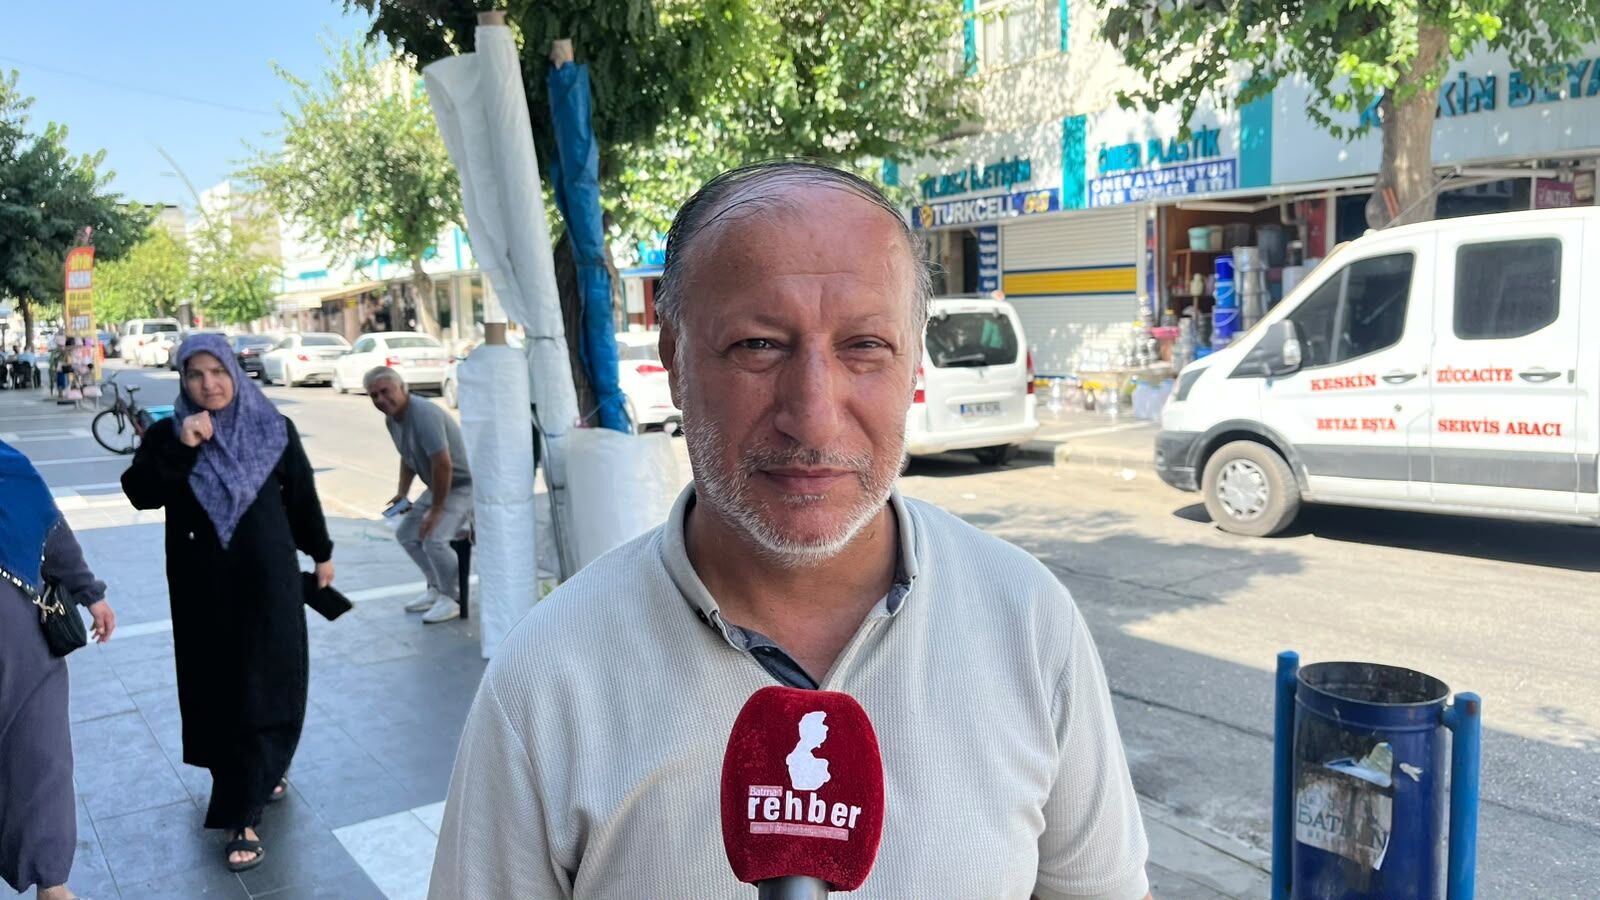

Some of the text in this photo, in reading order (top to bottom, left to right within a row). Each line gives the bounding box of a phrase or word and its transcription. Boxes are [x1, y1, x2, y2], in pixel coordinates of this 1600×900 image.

[1359, 72, 1496, 128] KKİN
[932, 196, 1018, 225] TURKCELL
[1311, 372, 1376, 391] KESKİN
[1317, 418, 1357, 430] BEYAZ
[1438, 417, 1562, 437] SERVİS ARACI
[750, 787, 782, 797] Batman
[748, 790, 862, 829] rehber
